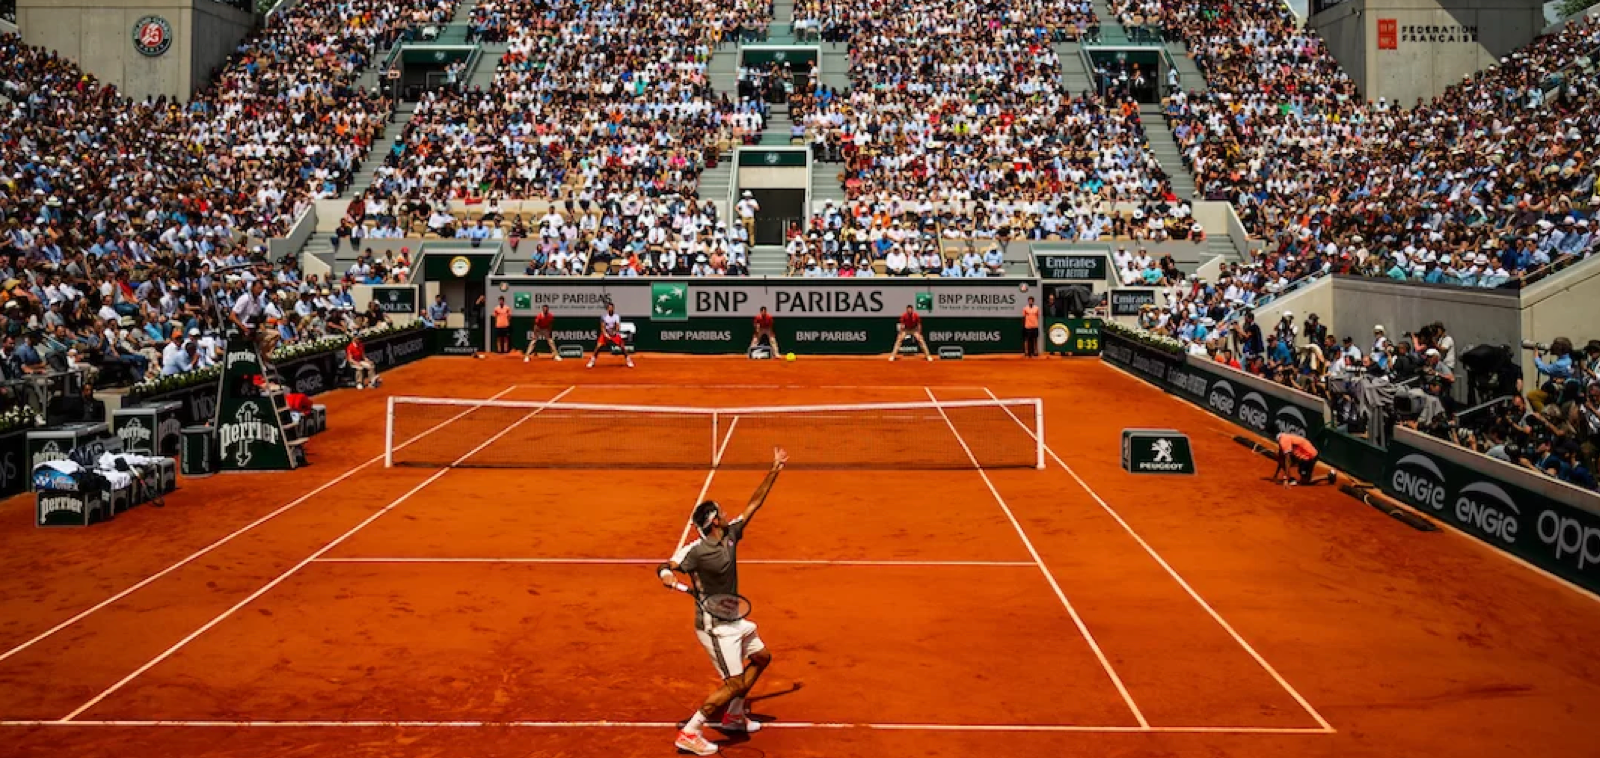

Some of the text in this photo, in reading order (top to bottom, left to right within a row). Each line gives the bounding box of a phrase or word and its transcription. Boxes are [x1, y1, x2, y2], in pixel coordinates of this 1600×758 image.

[1045, 256, 1097, 269] Emirates
[535, 293, 612, 304] BNP PARIBAS
[695, 291, 884, 312] BNP PARIBAS
[938, 294, 1016, 305] BNP PARIBAS
[552, 331, 597, 340] PARIBAS
[660, 331, 731, 340] BNP PARIBAS
[796, 331, 867, 341] BNP PARIBAS
[929, 331, 1001, 341] BNP PARIBAS
